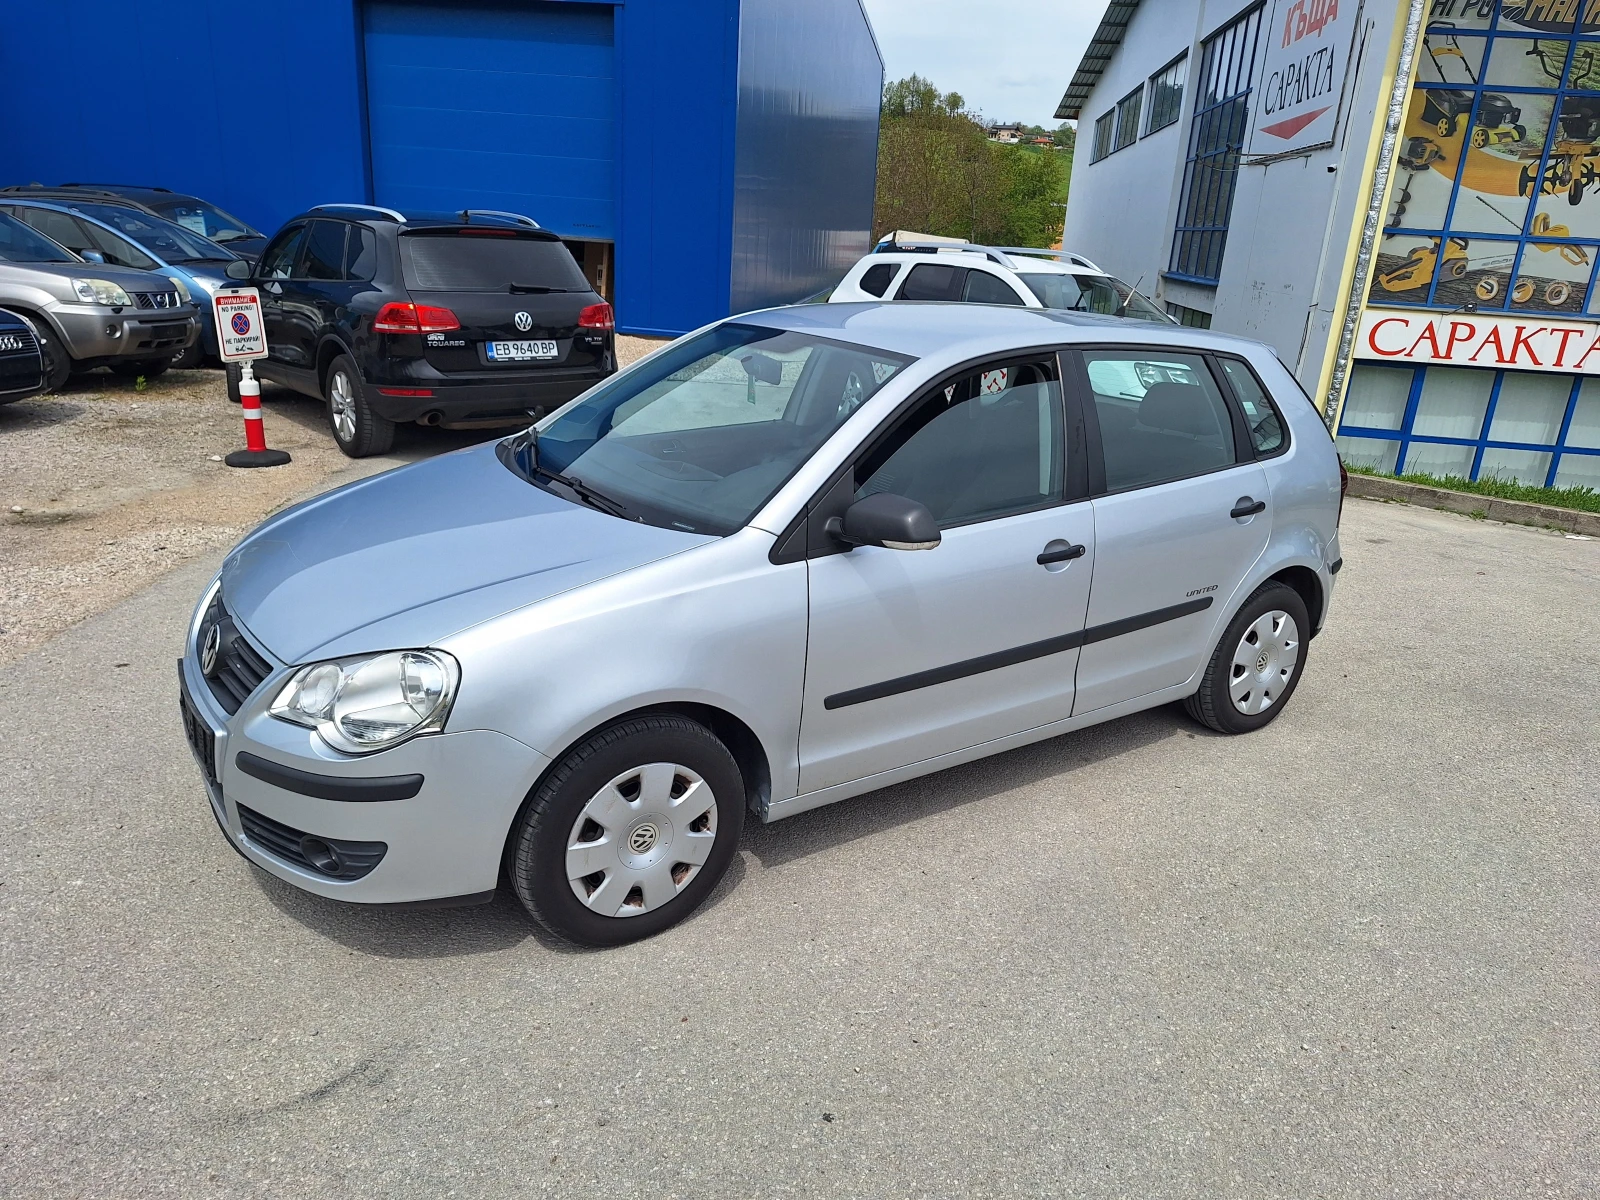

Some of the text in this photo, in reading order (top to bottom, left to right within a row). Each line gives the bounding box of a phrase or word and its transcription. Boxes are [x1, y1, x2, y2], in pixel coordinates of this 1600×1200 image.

[1265, 43, 1334, 115] САРАКТА
[220, 296, 253, 305] ВНИМАНИЕ!
[495, 342, 555, 356] EB 9640 BP
[1185, 584, 1219, 598] UNITED
